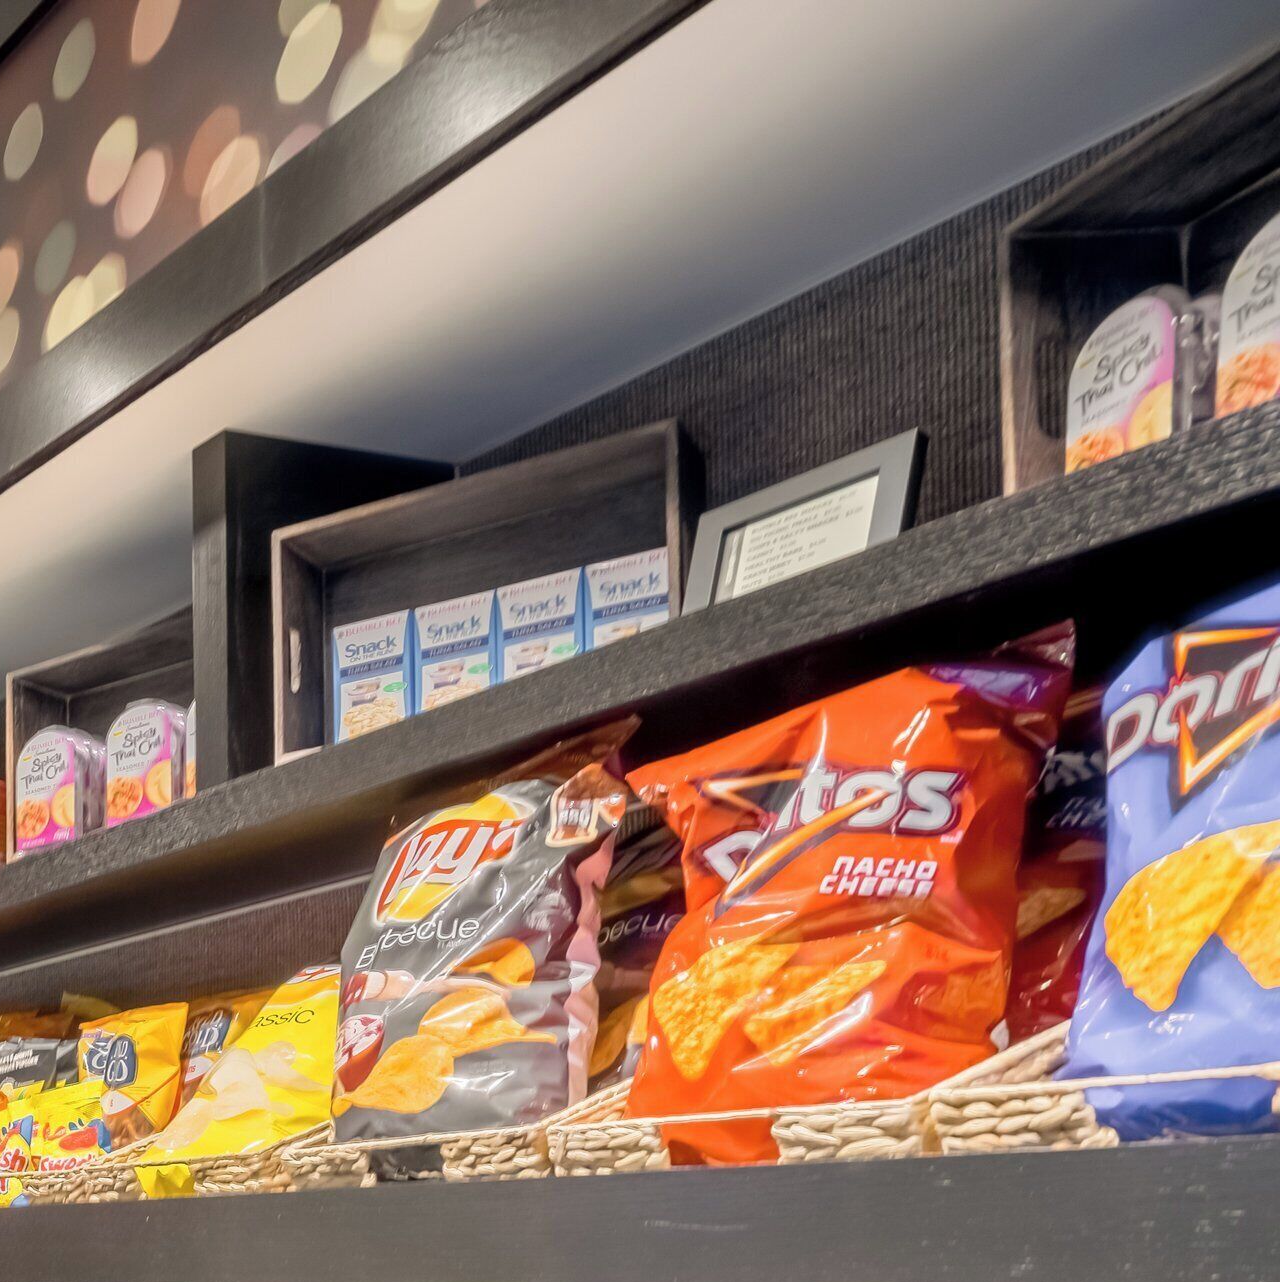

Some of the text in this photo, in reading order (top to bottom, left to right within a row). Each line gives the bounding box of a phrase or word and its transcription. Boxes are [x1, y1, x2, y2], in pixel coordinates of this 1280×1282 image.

[345, 635, 397, 659] Snack
[122, 727, 157, 748] Spicy
[31, 752, 62, 773] Spicy
[111, 751, 136, 766] Thai
[21, 775, 44, 789] Thai
[832, 856, 938, 879] NACHO
[255, 1006, 315, 1028] assic
